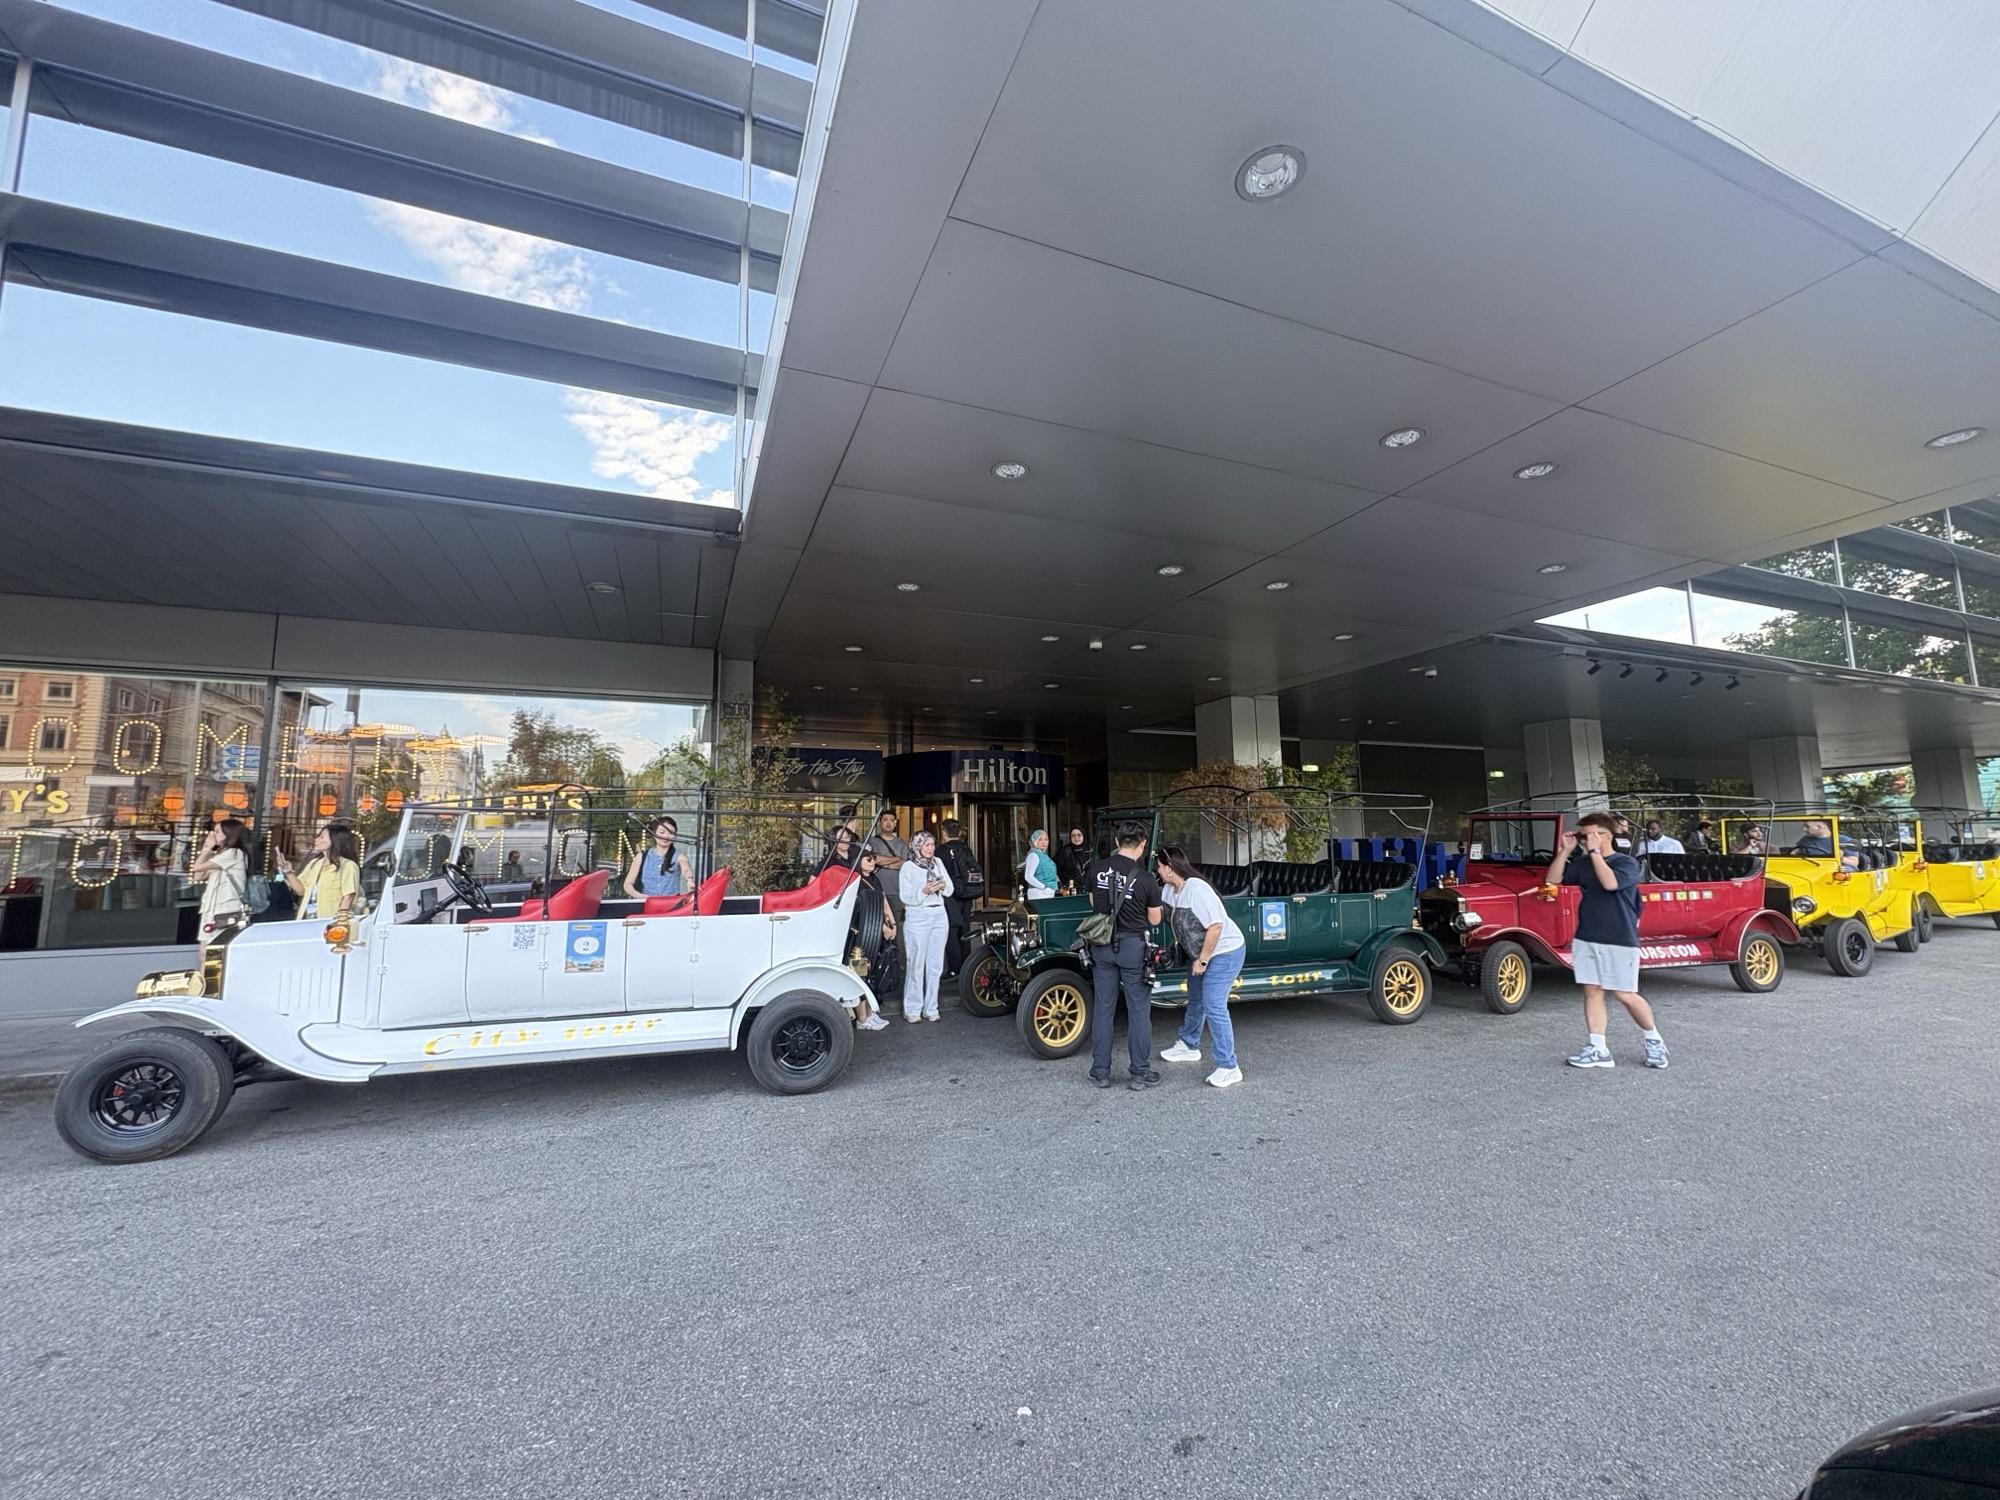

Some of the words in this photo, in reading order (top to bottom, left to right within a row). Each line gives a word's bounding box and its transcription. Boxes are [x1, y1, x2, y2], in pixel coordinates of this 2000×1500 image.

[27, 715, 311, 779] COME
[807, 758, 832, 776] the
[827, 757, 866, 786] Stay
[962, 758, 1047, 785] Hilton
[0, 784, 70, 814] Y'S
[1270, 970, 1322, 986] tour
